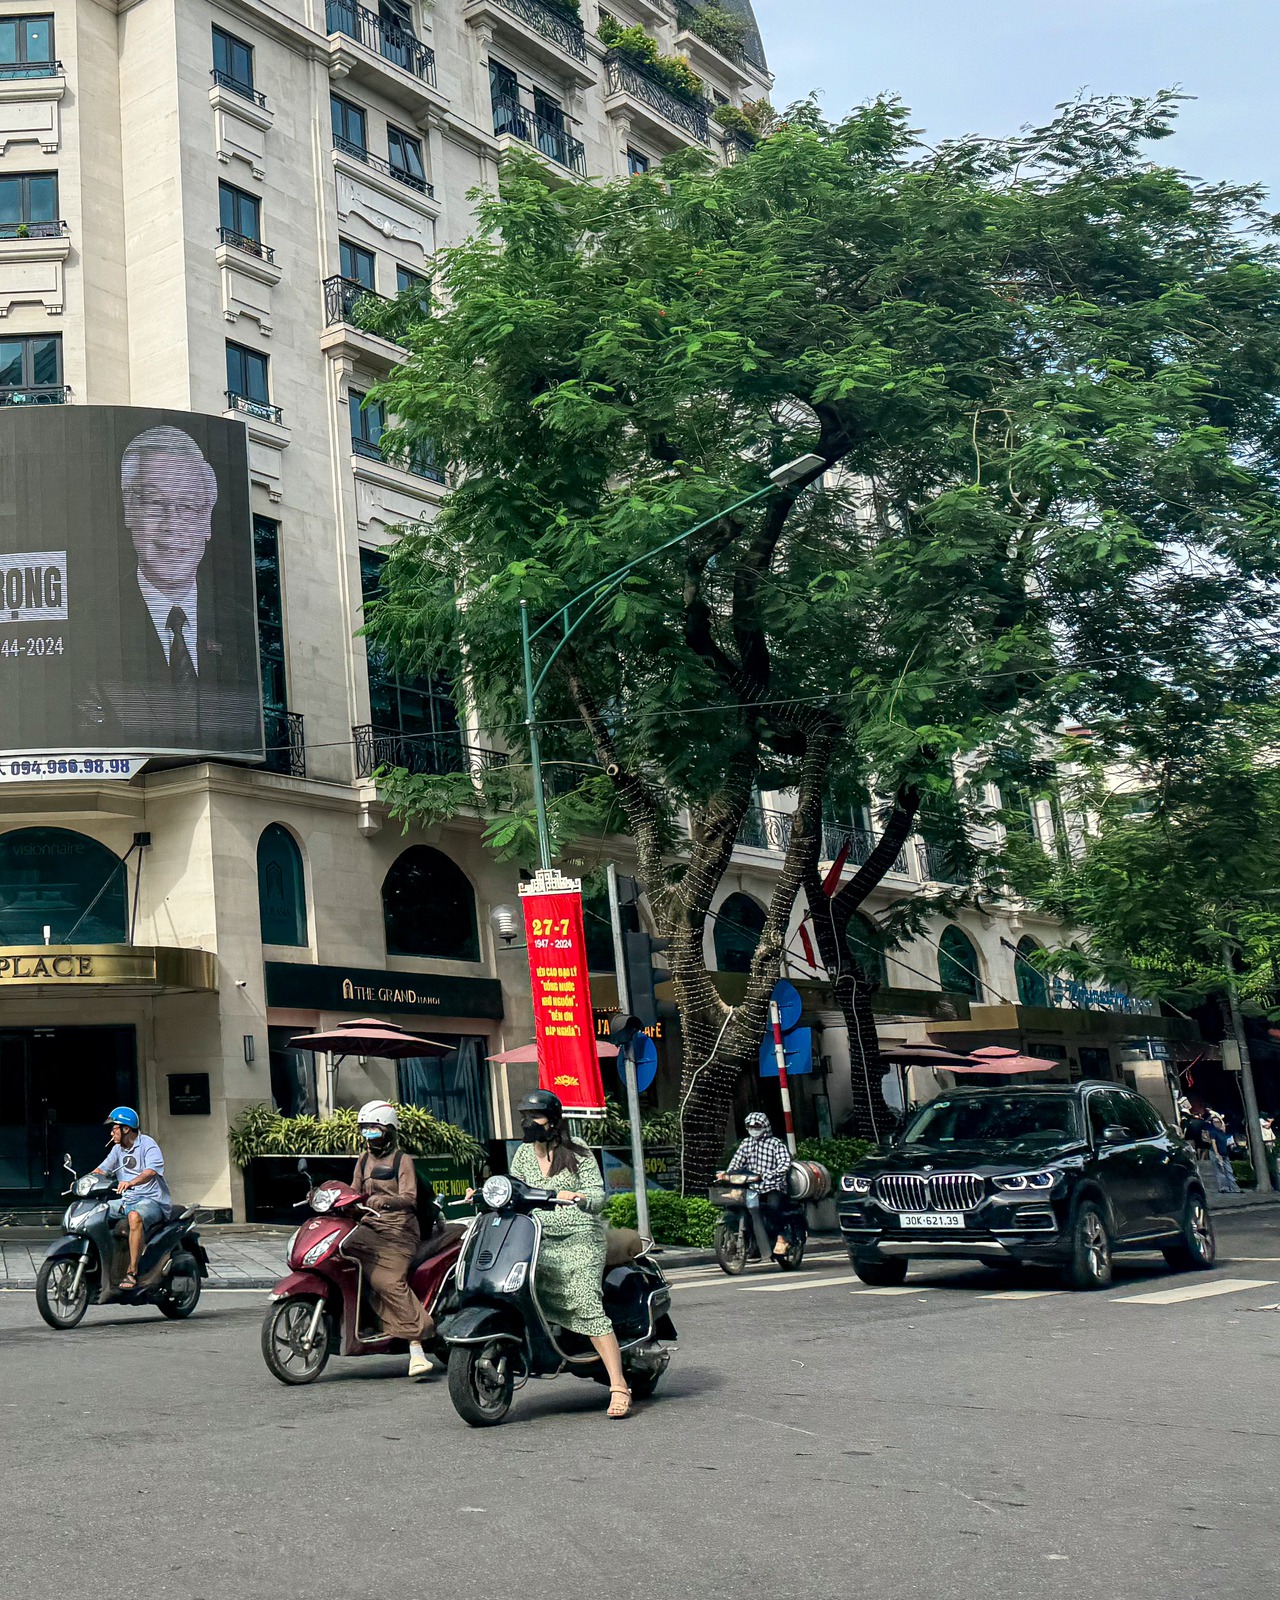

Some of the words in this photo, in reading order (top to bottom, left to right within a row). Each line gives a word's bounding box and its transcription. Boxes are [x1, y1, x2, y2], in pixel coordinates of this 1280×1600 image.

[13, 842, 86, 856] visionnaire
[532, 918, 570, 936] 27-7
[534, 939, 549, 949] 1947
[555, 939, 572, 949] 2024
[354, 986, 377, 1001] THE
[378, 987, 417, 1004] GRAND
